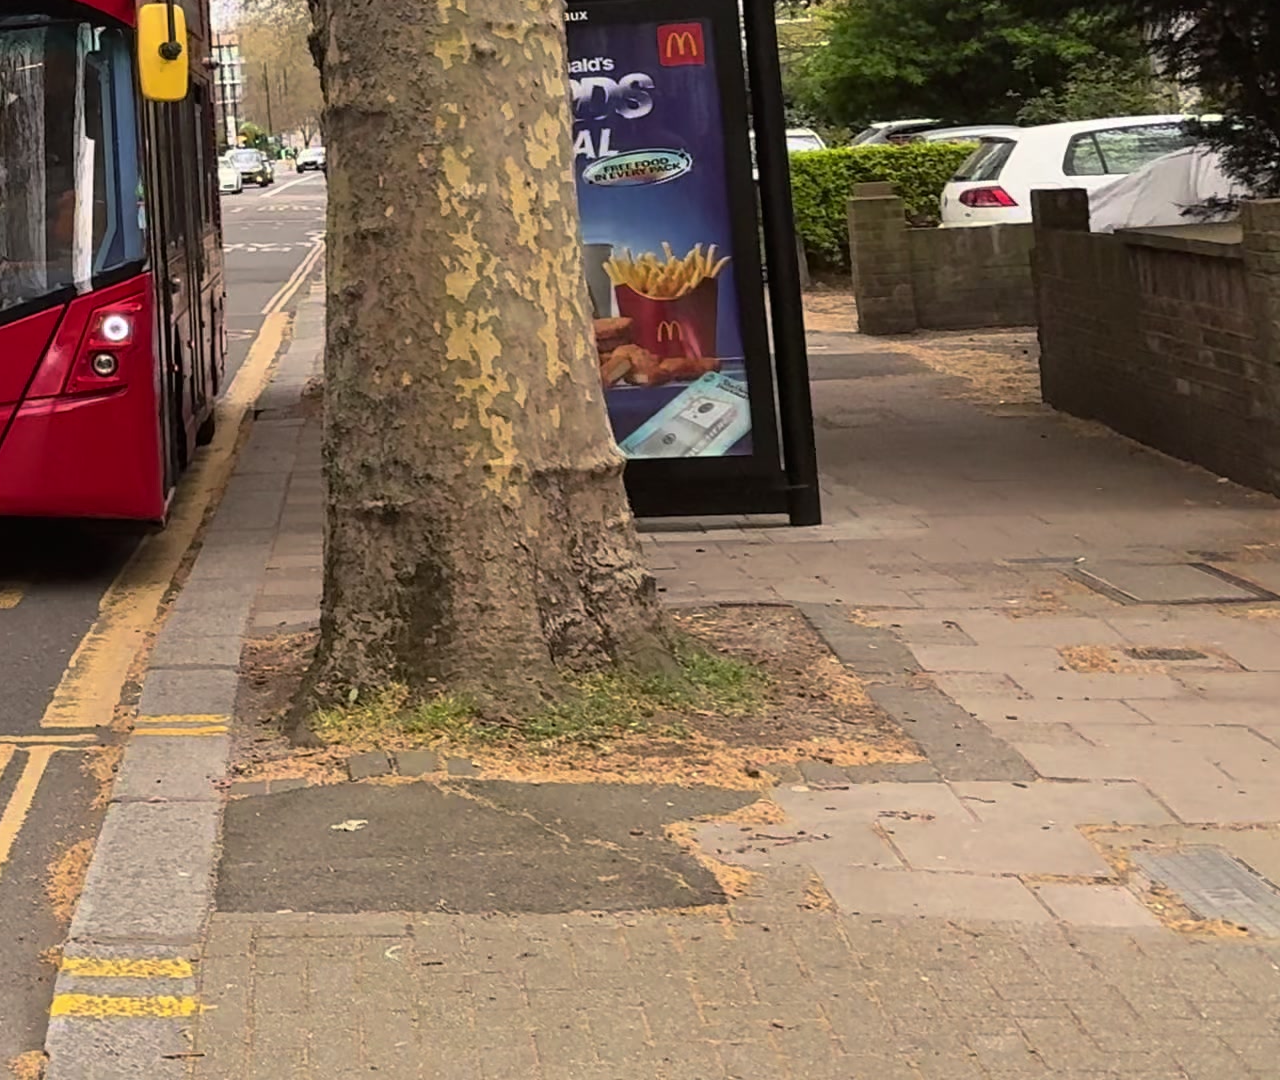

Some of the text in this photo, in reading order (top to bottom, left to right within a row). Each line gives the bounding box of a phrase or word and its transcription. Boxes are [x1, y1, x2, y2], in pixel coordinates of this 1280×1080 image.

[594, 162, 681, 182] IN EVERY PACK
[604, 157, 669, 174] FREE FOOD
